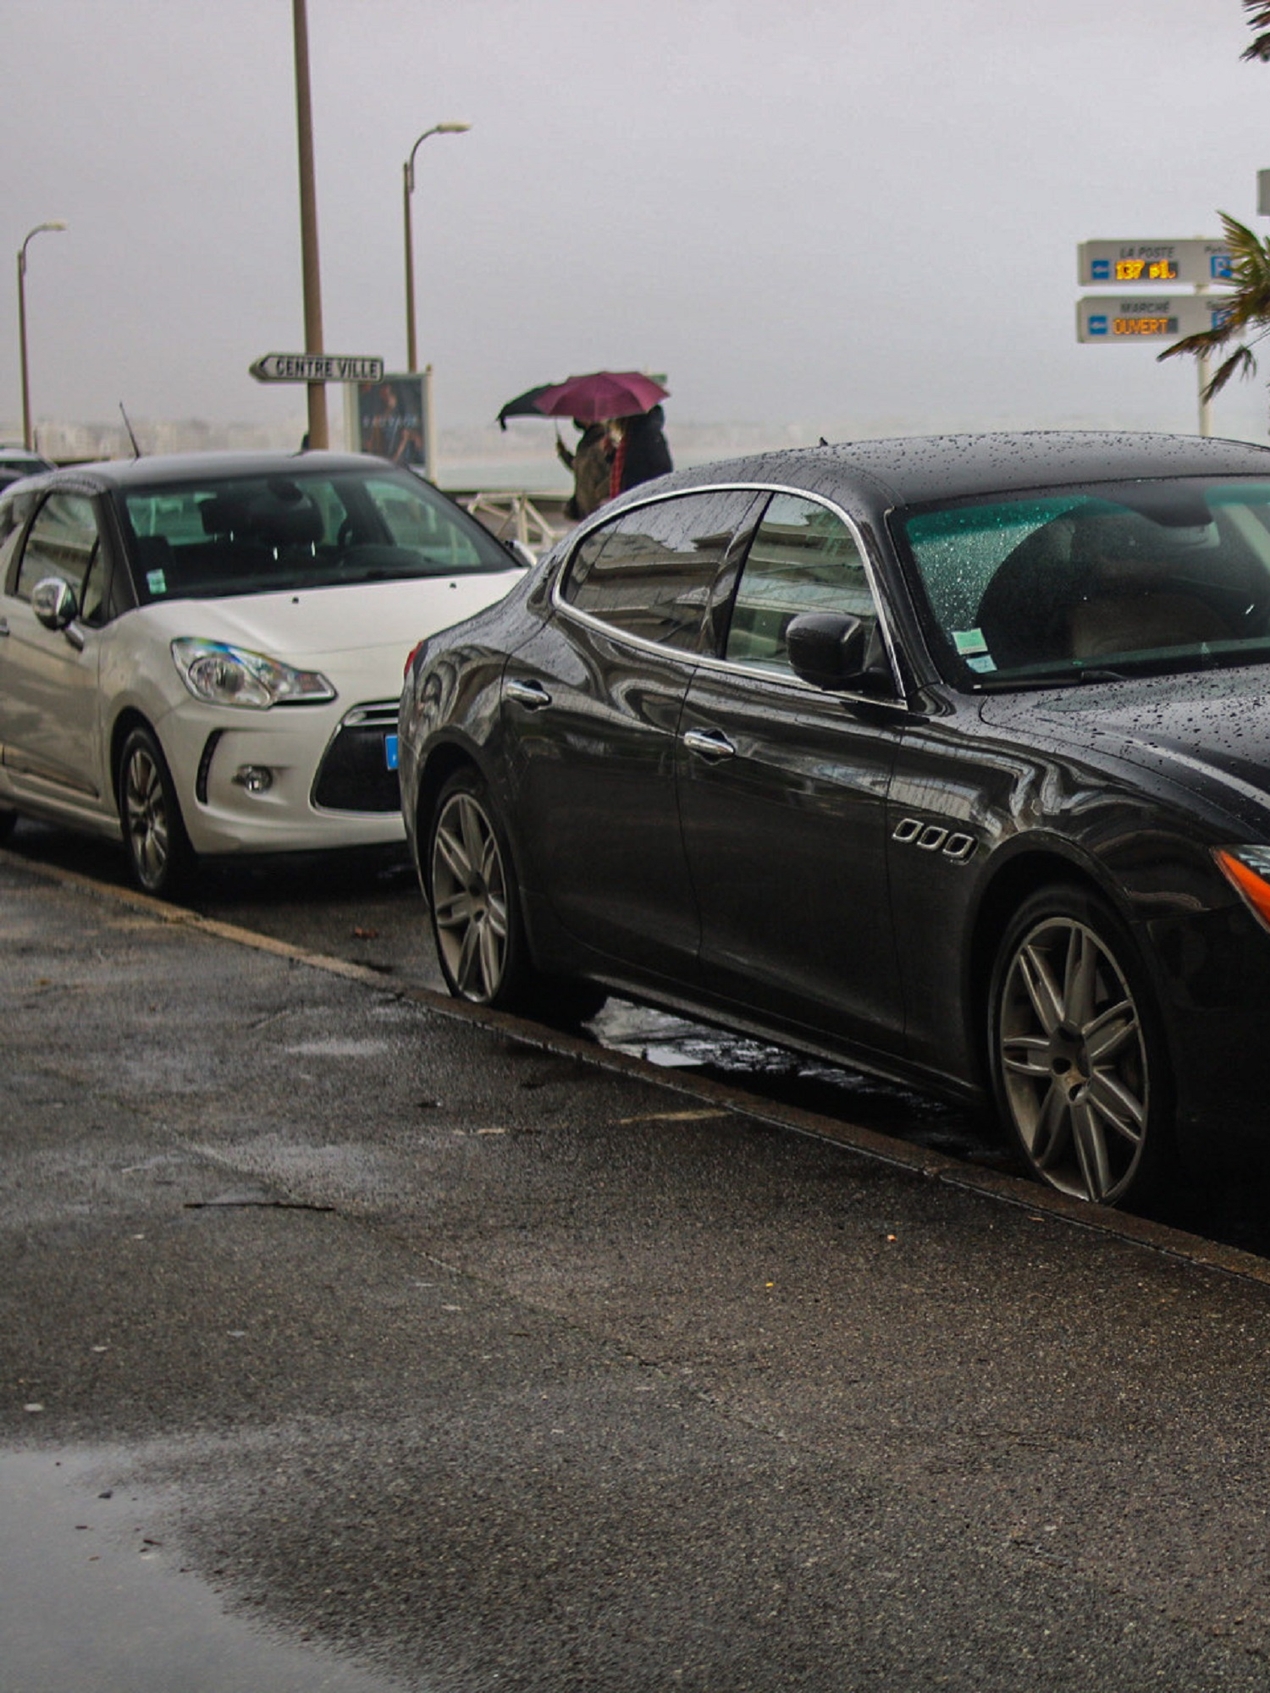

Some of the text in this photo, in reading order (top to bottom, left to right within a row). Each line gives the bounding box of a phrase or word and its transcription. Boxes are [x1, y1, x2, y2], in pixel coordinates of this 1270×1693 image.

[1120, 246, 1175, 258] LA POSTE
[1115, 259, 1146, 280] 137
[1121, 301, 1170, 313] MARCHÉ
[1113, 318, 1168, 335] OUVERT
[276, 358, 378, 379] CENTRE VILLE
